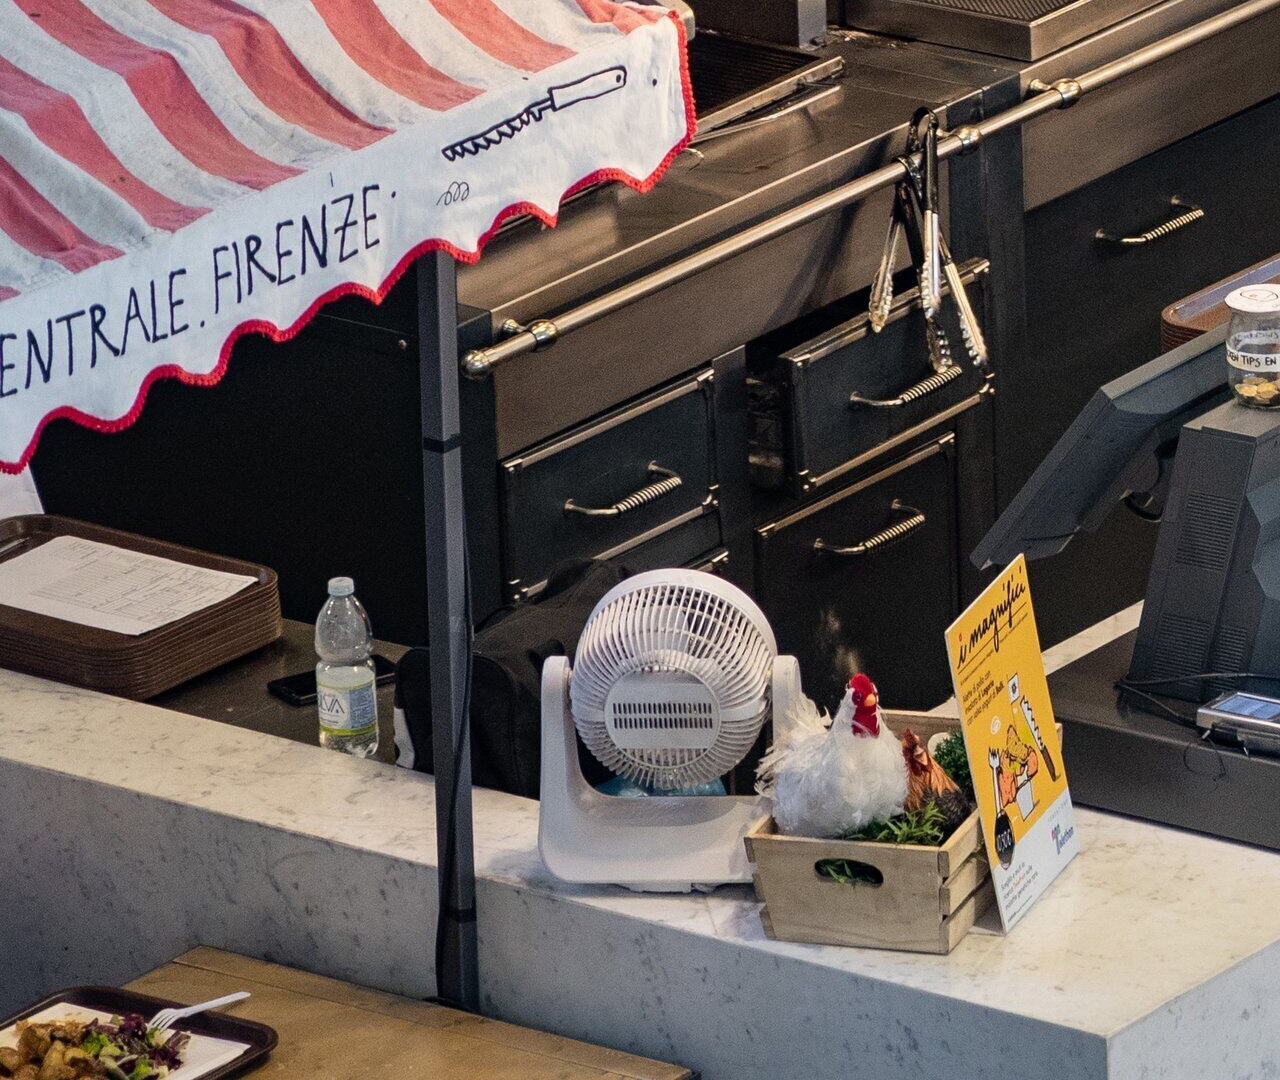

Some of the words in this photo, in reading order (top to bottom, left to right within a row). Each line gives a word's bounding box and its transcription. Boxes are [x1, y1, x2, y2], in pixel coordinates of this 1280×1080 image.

[1241, 354, 1261, 368] TIPS
[1265, 357, 1277, 366] EN
[968, 566, 1026, 653] magnifici
